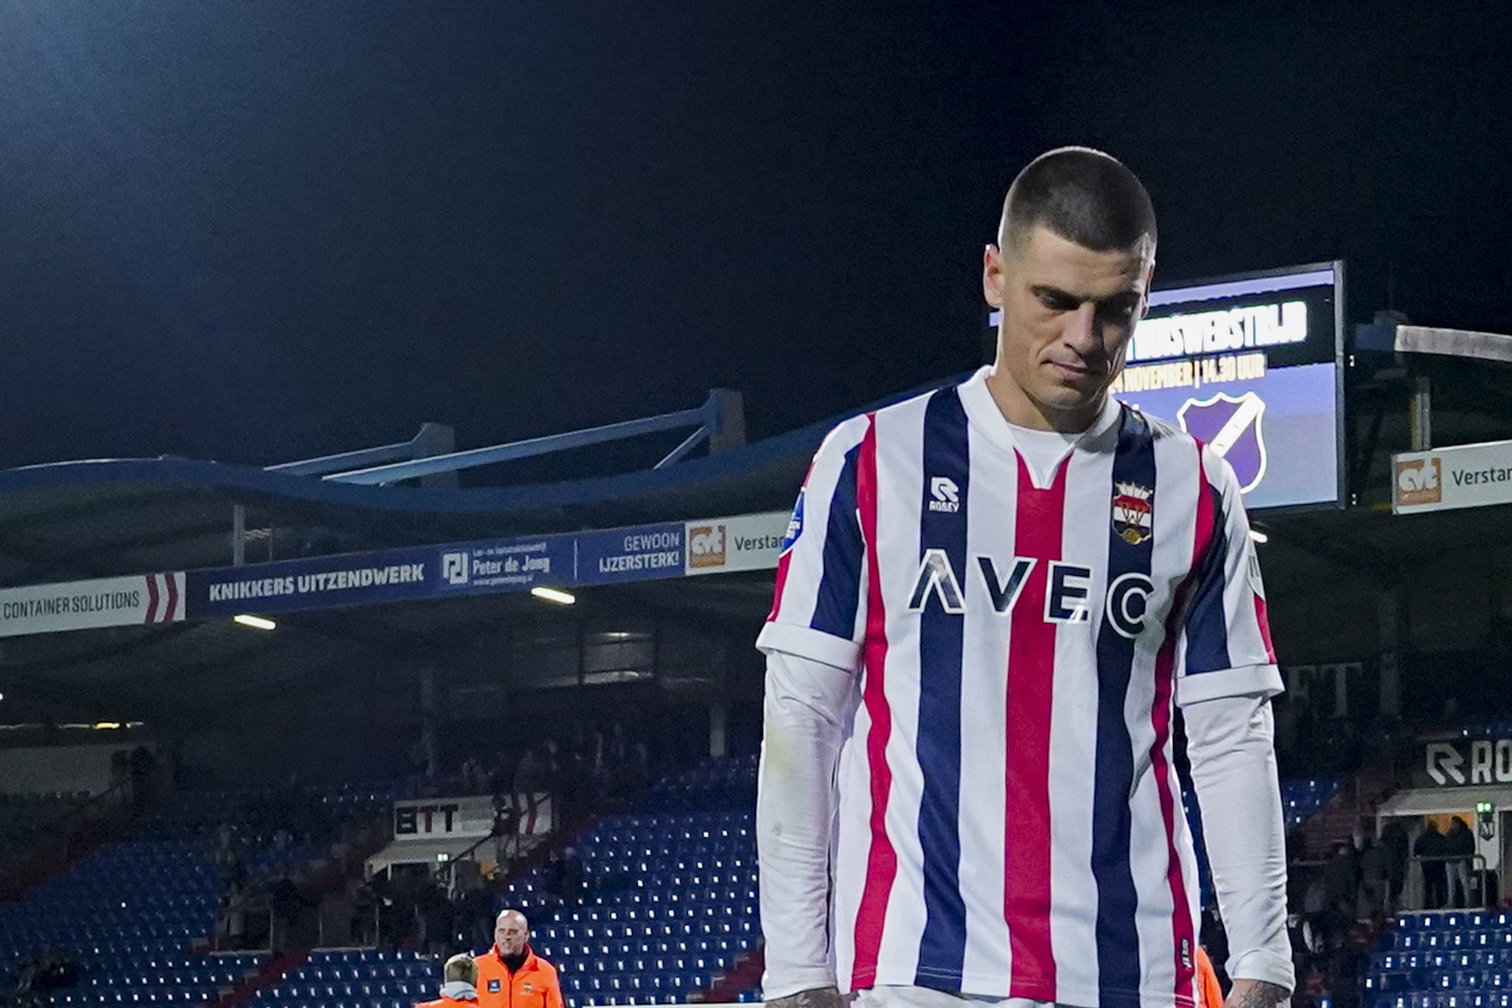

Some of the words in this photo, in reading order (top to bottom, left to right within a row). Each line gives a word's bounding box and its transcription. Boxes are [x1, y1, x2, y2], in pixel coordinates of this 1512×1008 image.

[624, 533, 680, 552] GEWOON
[473, 559, 502, 575] Peter
[504, 556, 519, 573] de
[521, 555, 550, 573] Jong
[599, 551, 680, 573] IJZERSTERK!
[209, 576, 295, 601] KNIKKERS
[297, 563, 425, 593] UITZENDWERK
[908, 548, 1156, 640] AVEC
[3, 595, 70, 620] CONTAINER
[72, 590, 140, 613] SOLUTIONS
